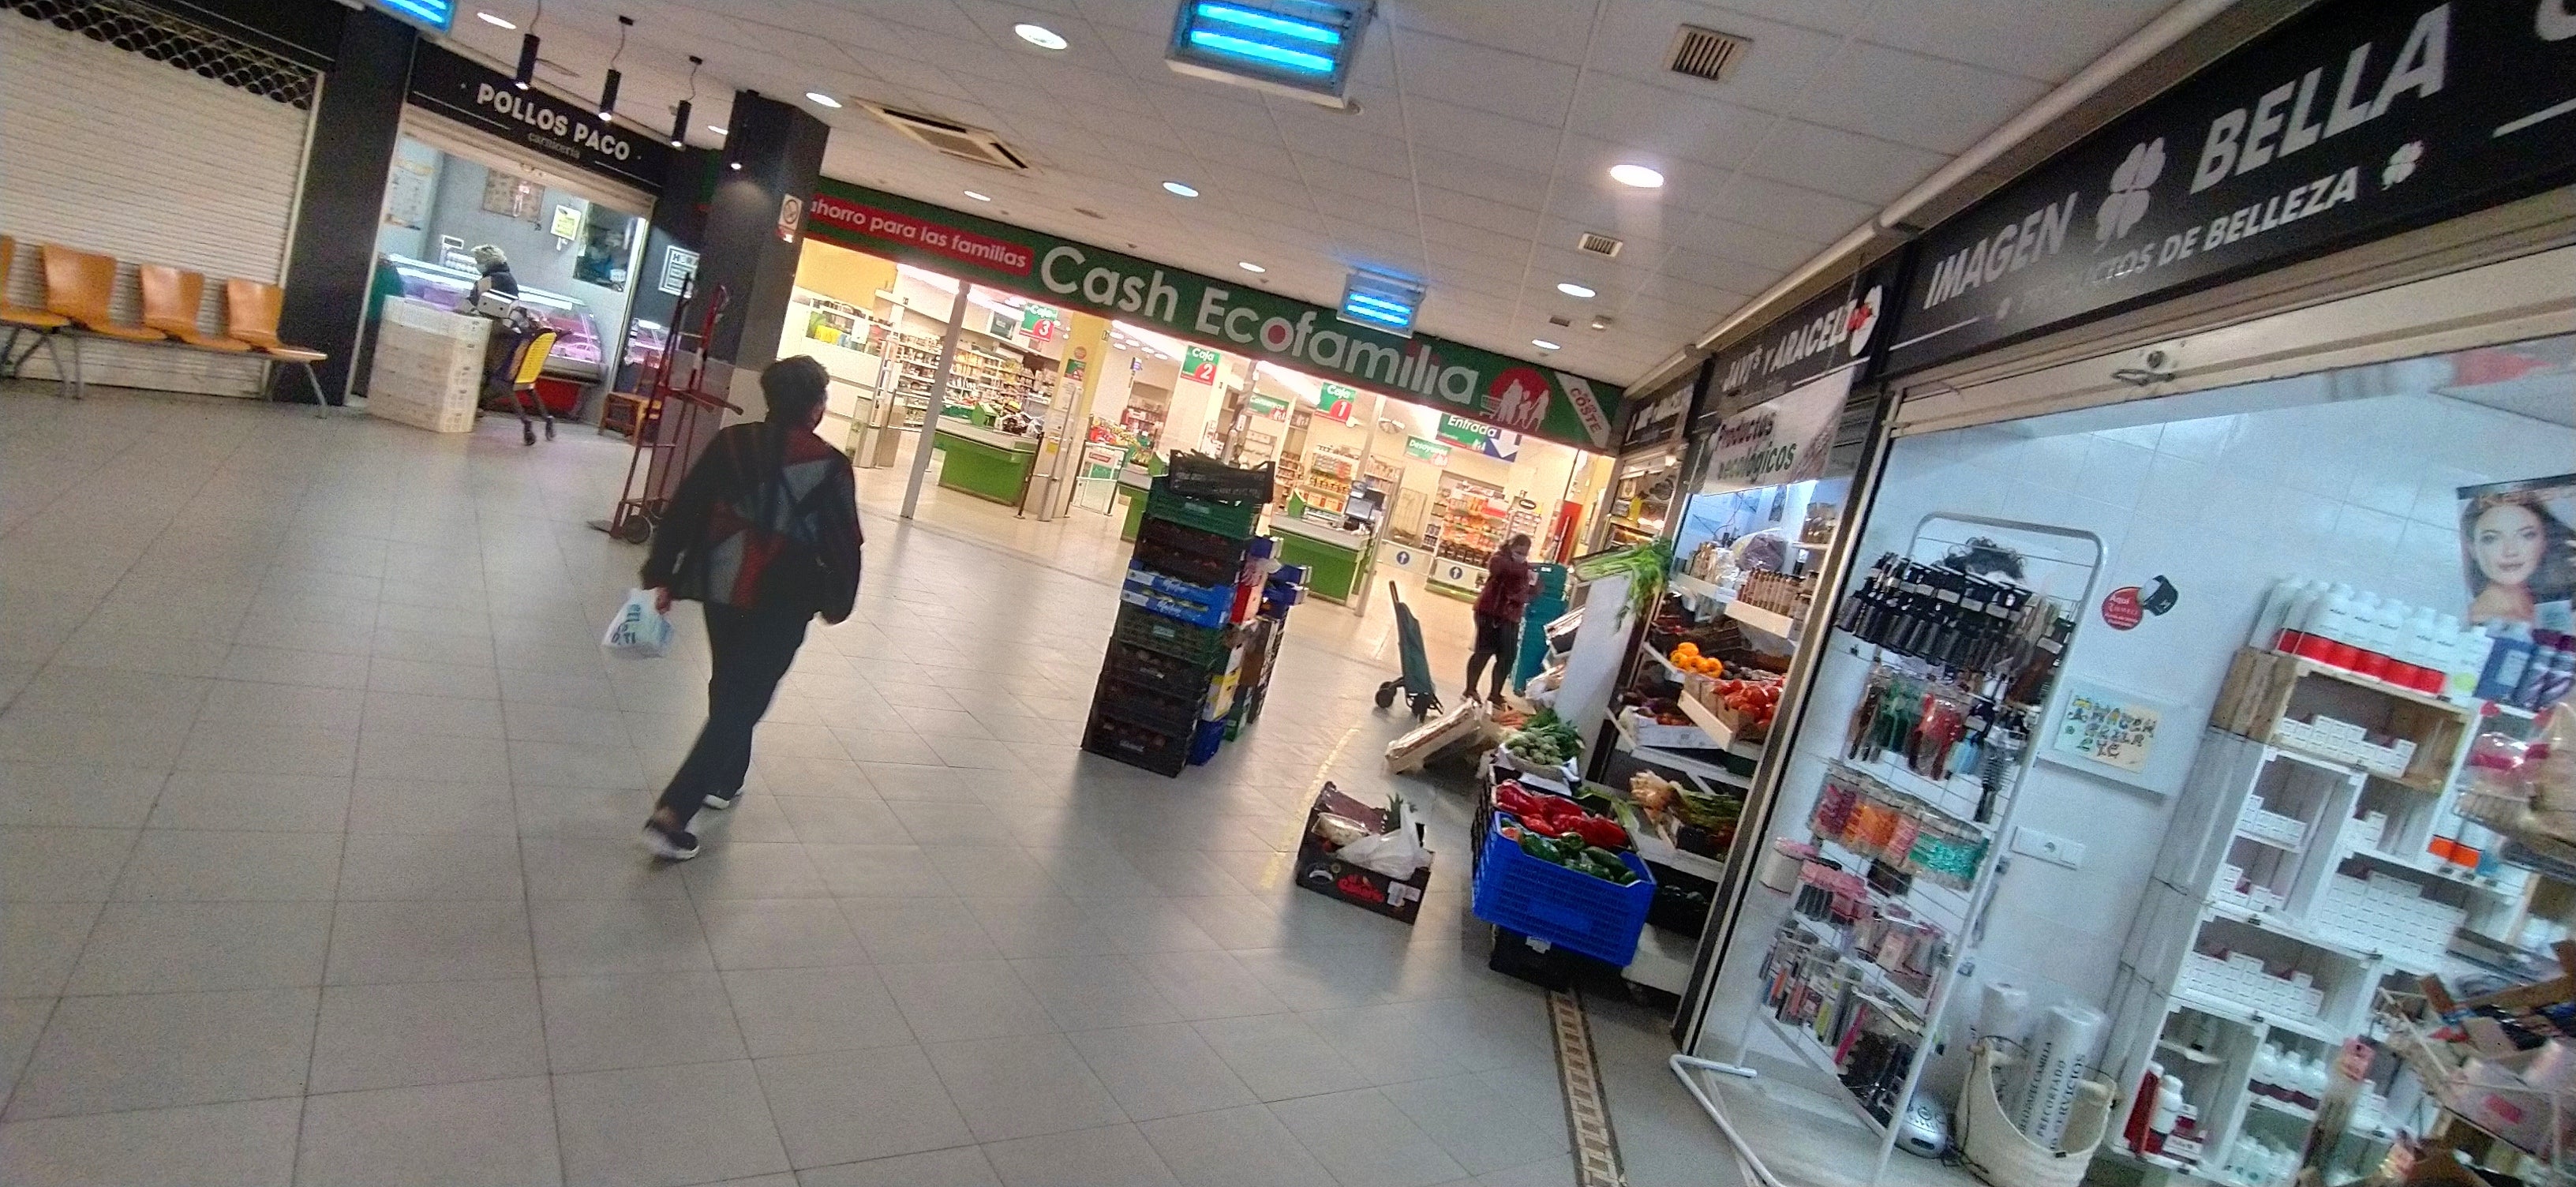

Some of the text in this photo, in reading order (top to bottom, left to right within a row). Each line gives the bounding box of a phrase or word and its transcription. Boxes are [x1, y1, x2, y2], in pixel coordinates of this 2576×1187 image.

[477, 83, 630, 160] POLLOS PACO
[1923, 3, 2450, 310] IMAGEN BELLA
[2157, 226, 2203, 268] DE
[2203, 166, 2359, 252] BELLEZA
[870, 216, 916, 238] para
[920, 227, 947, 247] las
[951, 235, 1027, 268] familias
[1039, 320, 1051, 336] 3
[1041, 245, 1481, 406] Cash Ecofamilia
[1770, 298, 1858, 373] ARACELI
[1192, 347, 1215, 361] Caja
[1200, 363, 1213, 380] 2
[1327, 384, 1351, 399] Caja
[1338, 401, 1348, 418] 1
[1571, 388, 1603, 433] COSTE
[1447, 415, 1498, 438] Entrada
